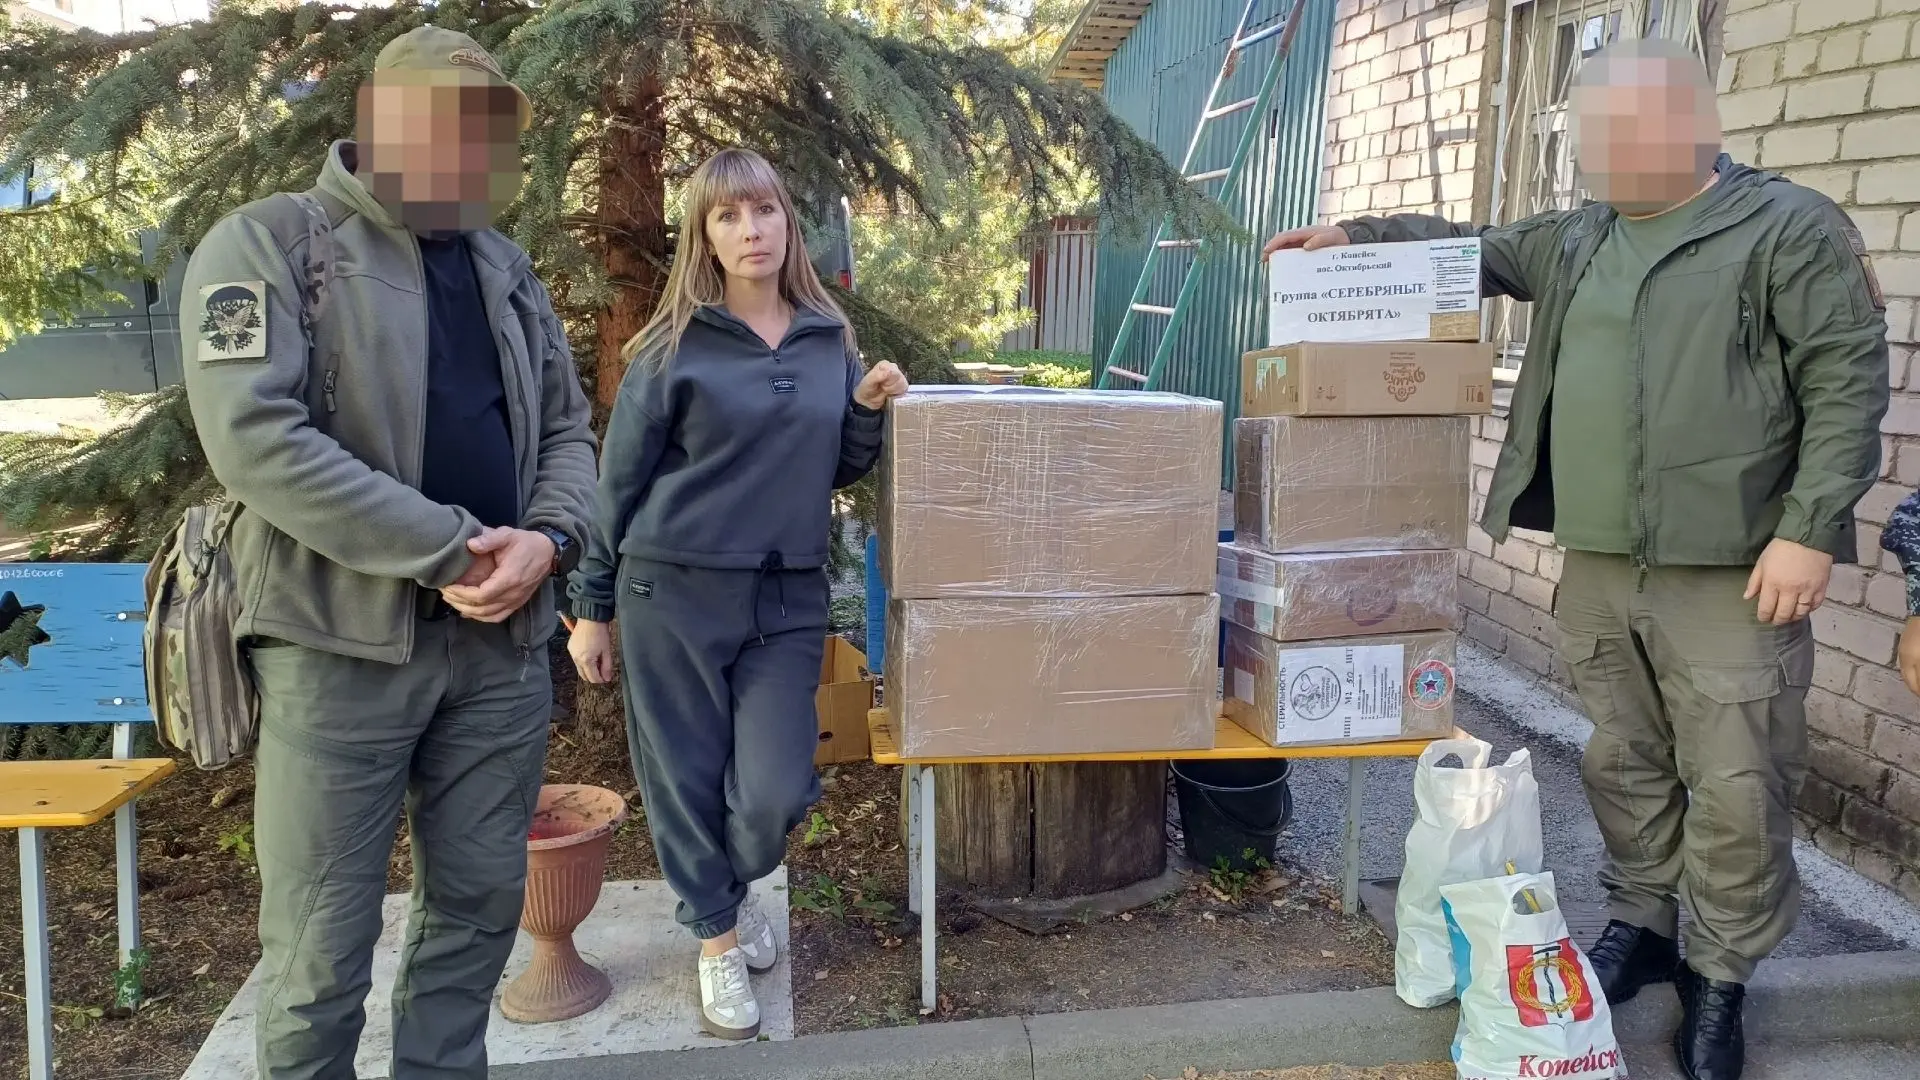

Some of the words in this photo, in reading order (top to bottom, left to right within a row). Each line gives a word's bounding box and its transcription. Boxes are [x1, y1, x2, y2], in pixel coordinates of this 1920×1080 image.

[1334, 261, 1392, 273] Октябрьский
[1273, 291, 1317, 304] Группа
[1321, 283, 1427, 299] «СЕРЕБРЯНЫЕ
[1307, 308, 1401, 323] ОКТЯБРЯТА»
[1279, 667, 1287, 730] СТЕРИЛЬНОСТЬ
